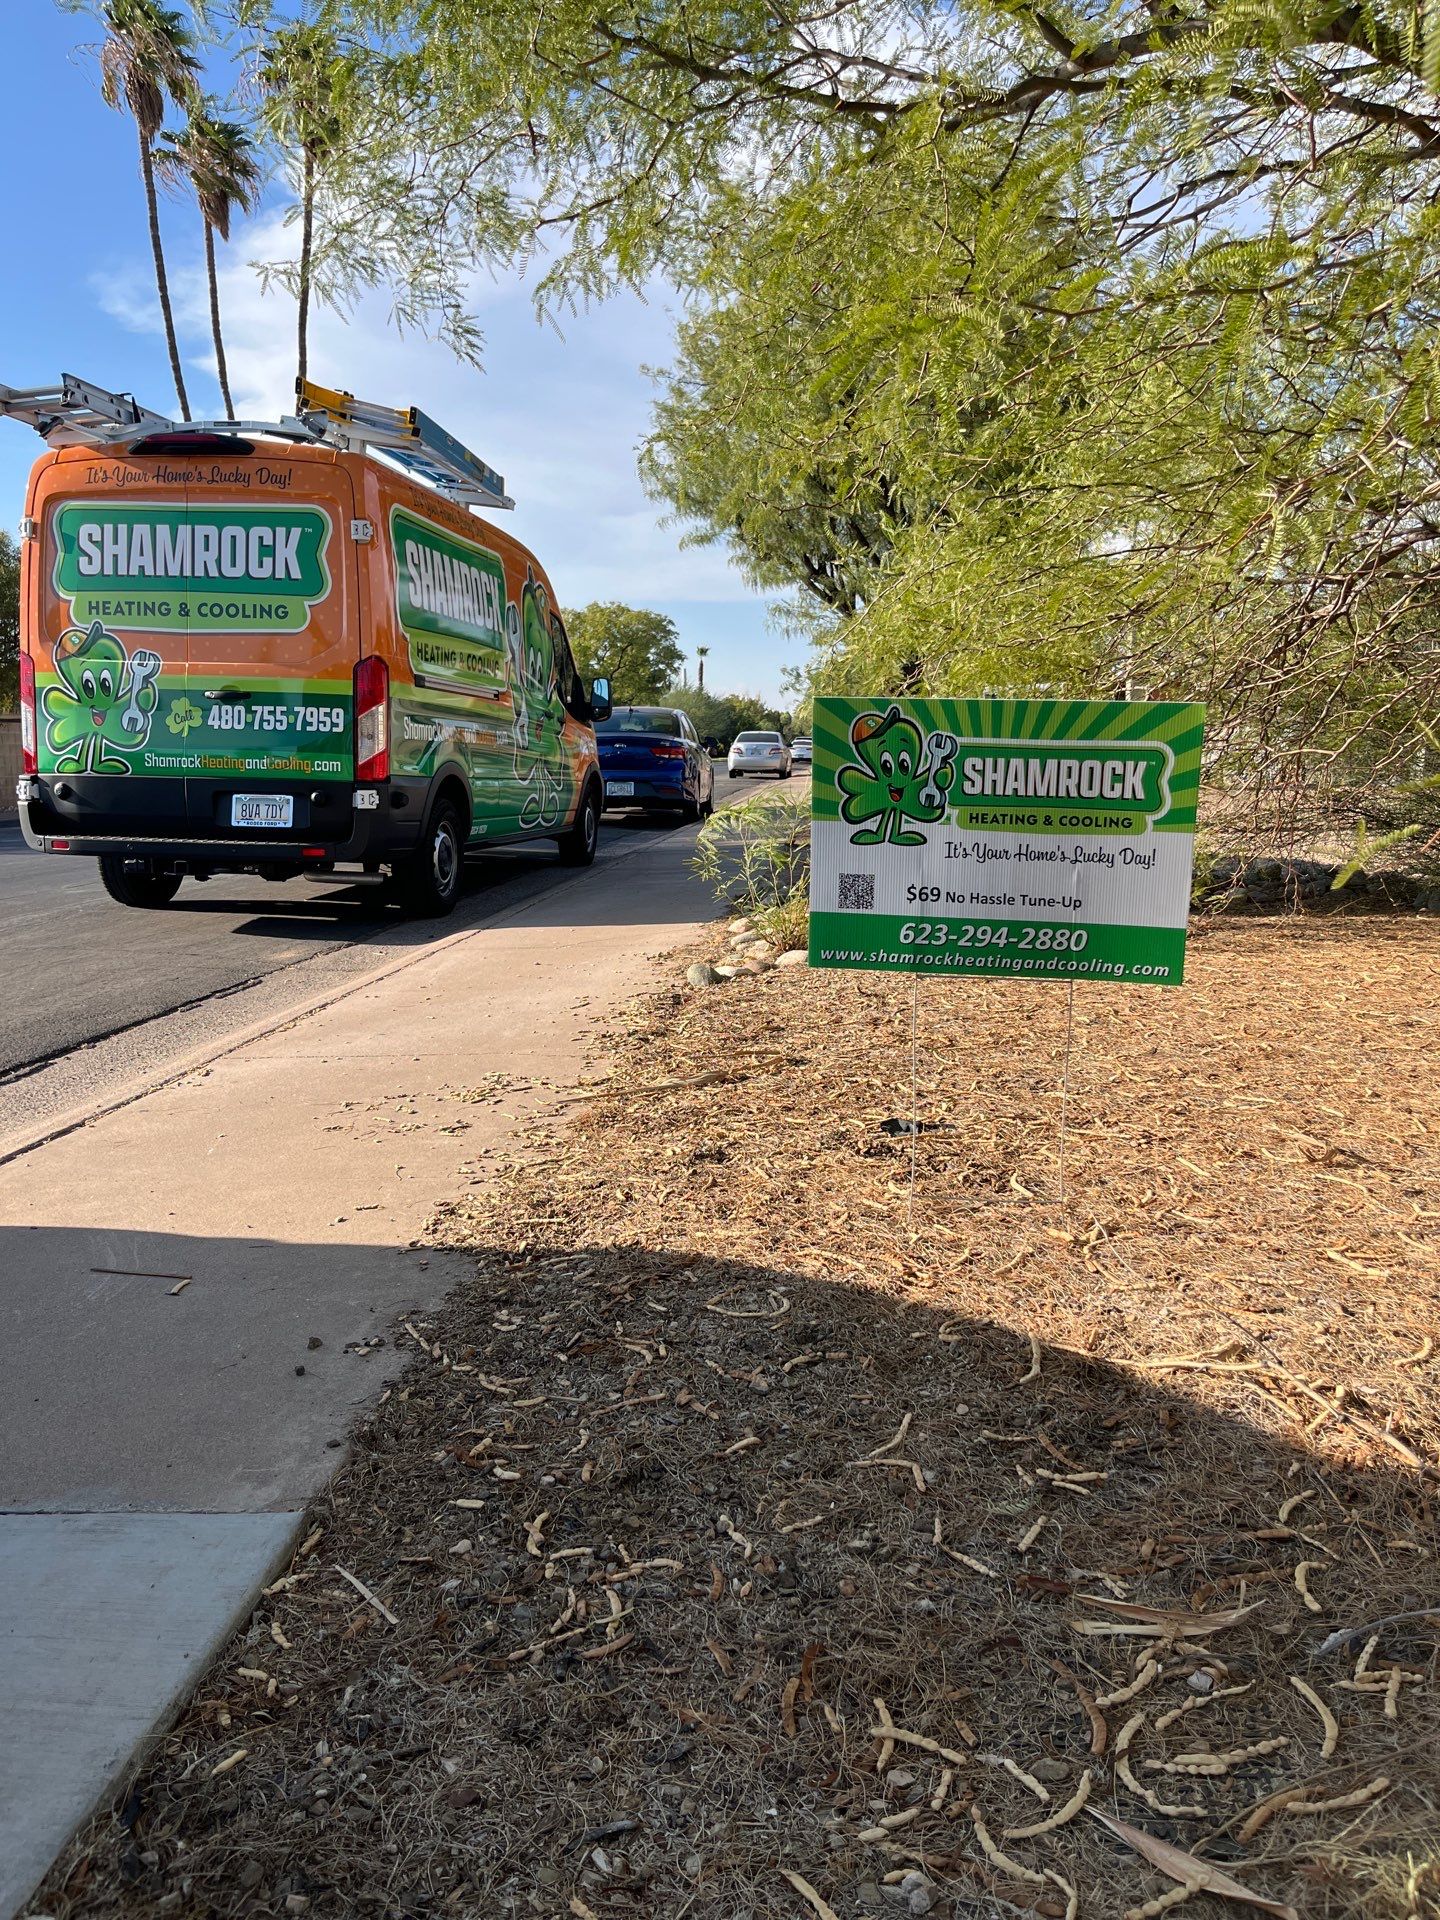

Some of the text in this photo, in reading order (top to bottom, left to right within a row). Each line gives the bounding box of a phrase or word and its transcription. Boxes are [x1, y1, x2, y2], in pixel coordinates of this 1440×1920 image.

[85, 465, 292, 490] It's Your Home's Lucky Day!
[78, 523, 303, 580] SHAMROCK
[405, 539, 504, 635] SHAMROCK
[88, 601, 290, 620] HEATING & COOLING
[416, 641, 457, 667] HEATING
[173, 709, 195, 725] Call
[144, 753, 341, 774] ShamrockHeatingandCooling.com
[961, 756, 1147, 801] SHAMROCK
[241, 803, 284, 819] 8VA 7DY
[969, 812, 1134, 829] HEATING & COOLING
[944, 841, 1157, 870] It's Your Home's Lucky Day!
[906, 884, 1082, 910] $69 No Hassle Tune-Up
[899, 922, 1088, 952] 623-294-2880
[820, 948, 1170, 978] www.shamrockheatingandcooling.com
